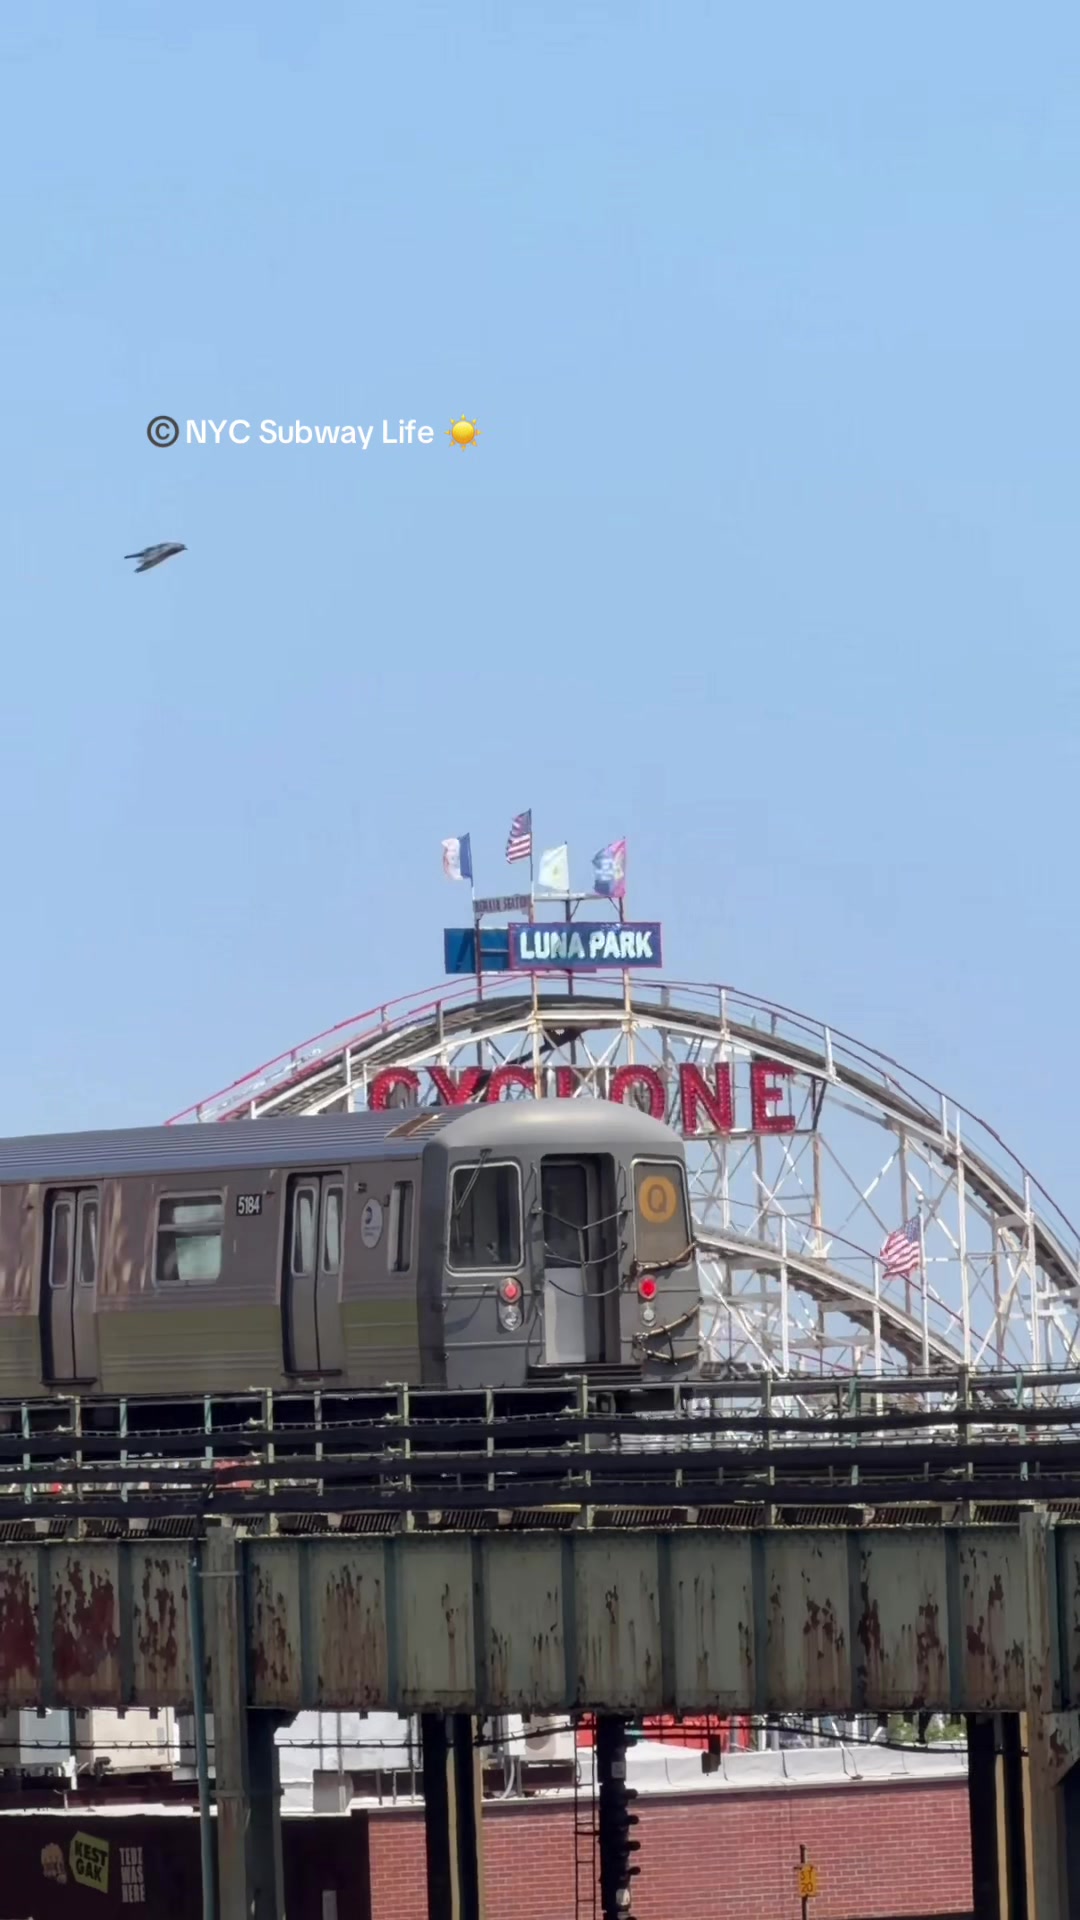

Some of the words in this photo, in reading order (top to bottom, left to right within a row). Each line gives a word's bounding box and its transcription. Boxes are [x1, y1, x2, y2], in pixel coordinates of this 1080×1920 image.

[519, 931, 586, 960] LUNA
[589, 930, 654, 960] PARK
[237, 1195, 261, 1215] 5184
[647, 1183, 668, 1214] Q
[121, 1866, 145, 1884] WAS
[122, 1884, 147, 1903] HERE
